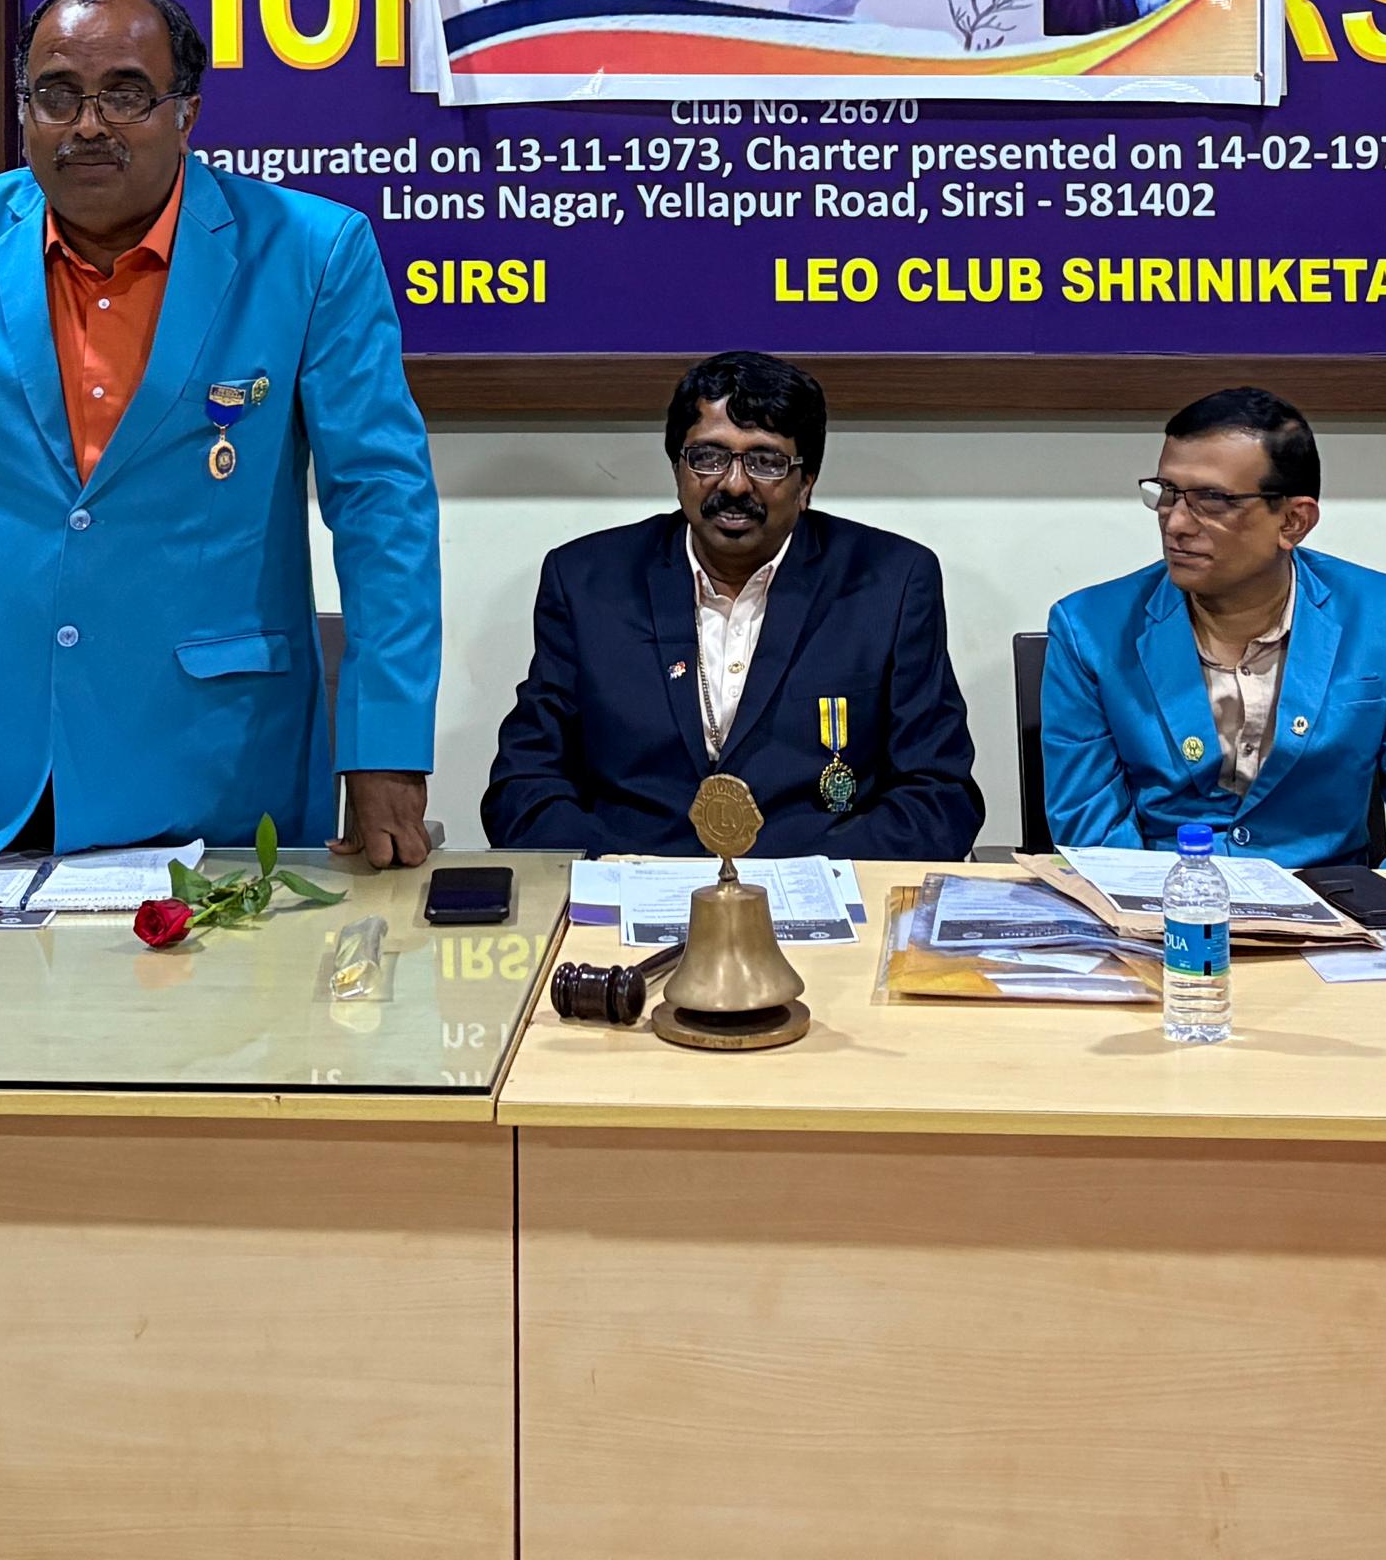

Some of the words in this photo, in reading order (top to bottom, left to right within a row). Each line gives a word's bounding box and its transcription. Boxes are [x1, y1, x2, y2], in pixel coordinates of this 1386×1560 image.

[670, 99, 742, 125] Club
[752, 99, 808, 124] No.
[819, 99, 919, 124] 26670
[430, 146, 481, 173] on
[494, 138, 733, 177] 13-11-1973,
[745, 135, 899, 171] Charter
[912, 135, 1115, 178] presented
[1129, 144, 1183, 170] on
[382, 184, 485, 221] Lions
[499, 185, 625, 226] Nagar,
[636, 182, 802, 226] Yellapur
[815, 182, 929, 224] Road,
[941, 182, 1025, 217] Sirsi
[1064, 183, 1216, 217] 581402
[405, 258, 547, 305] SIRSI
[774, 257, 879, 303] LEO
[897, 257, 1044, 303] CLUB
